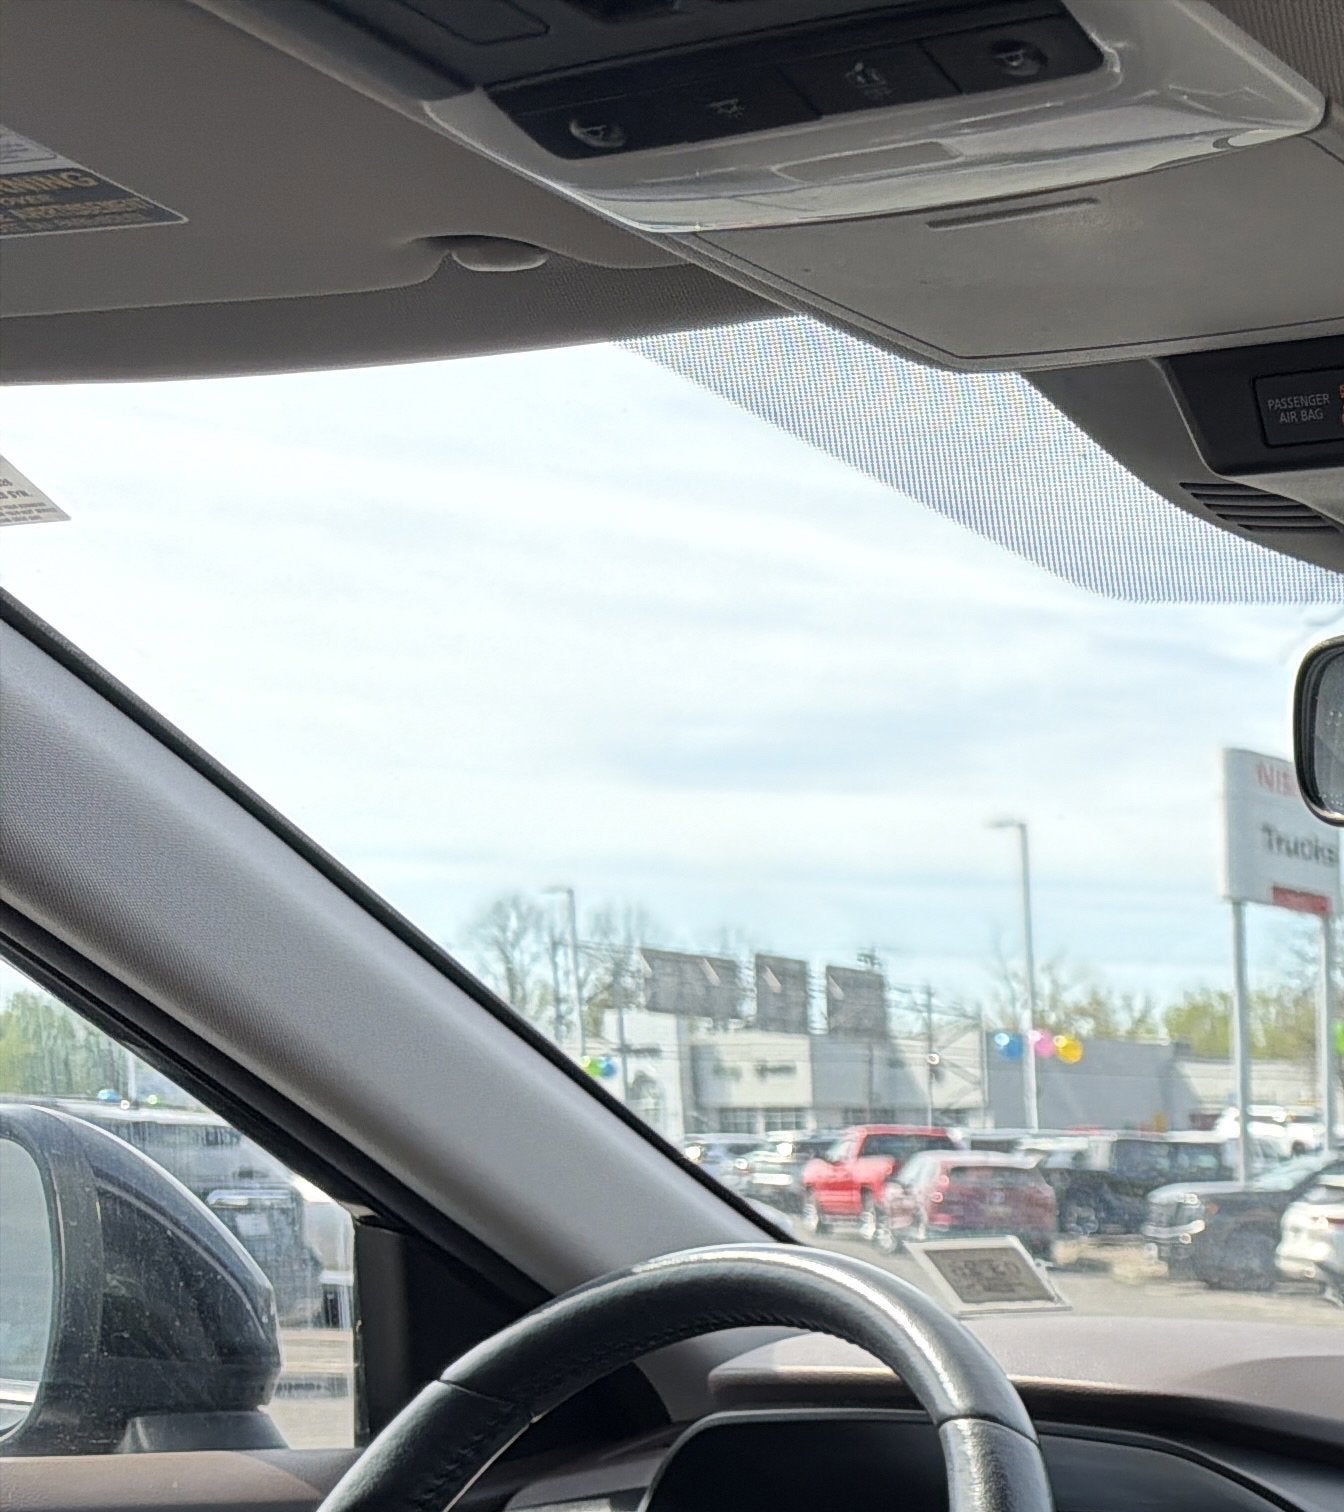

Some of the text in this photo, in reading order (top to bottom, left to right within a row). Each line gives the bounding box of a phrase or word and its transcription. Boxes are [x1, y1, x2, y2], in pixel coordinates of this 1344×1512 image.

[1267, 393, 1330, 410] PASSENGER
[1280, 408, 1324, 424] AIR BAG
[1261, 822, 1340, 868] Trucks
